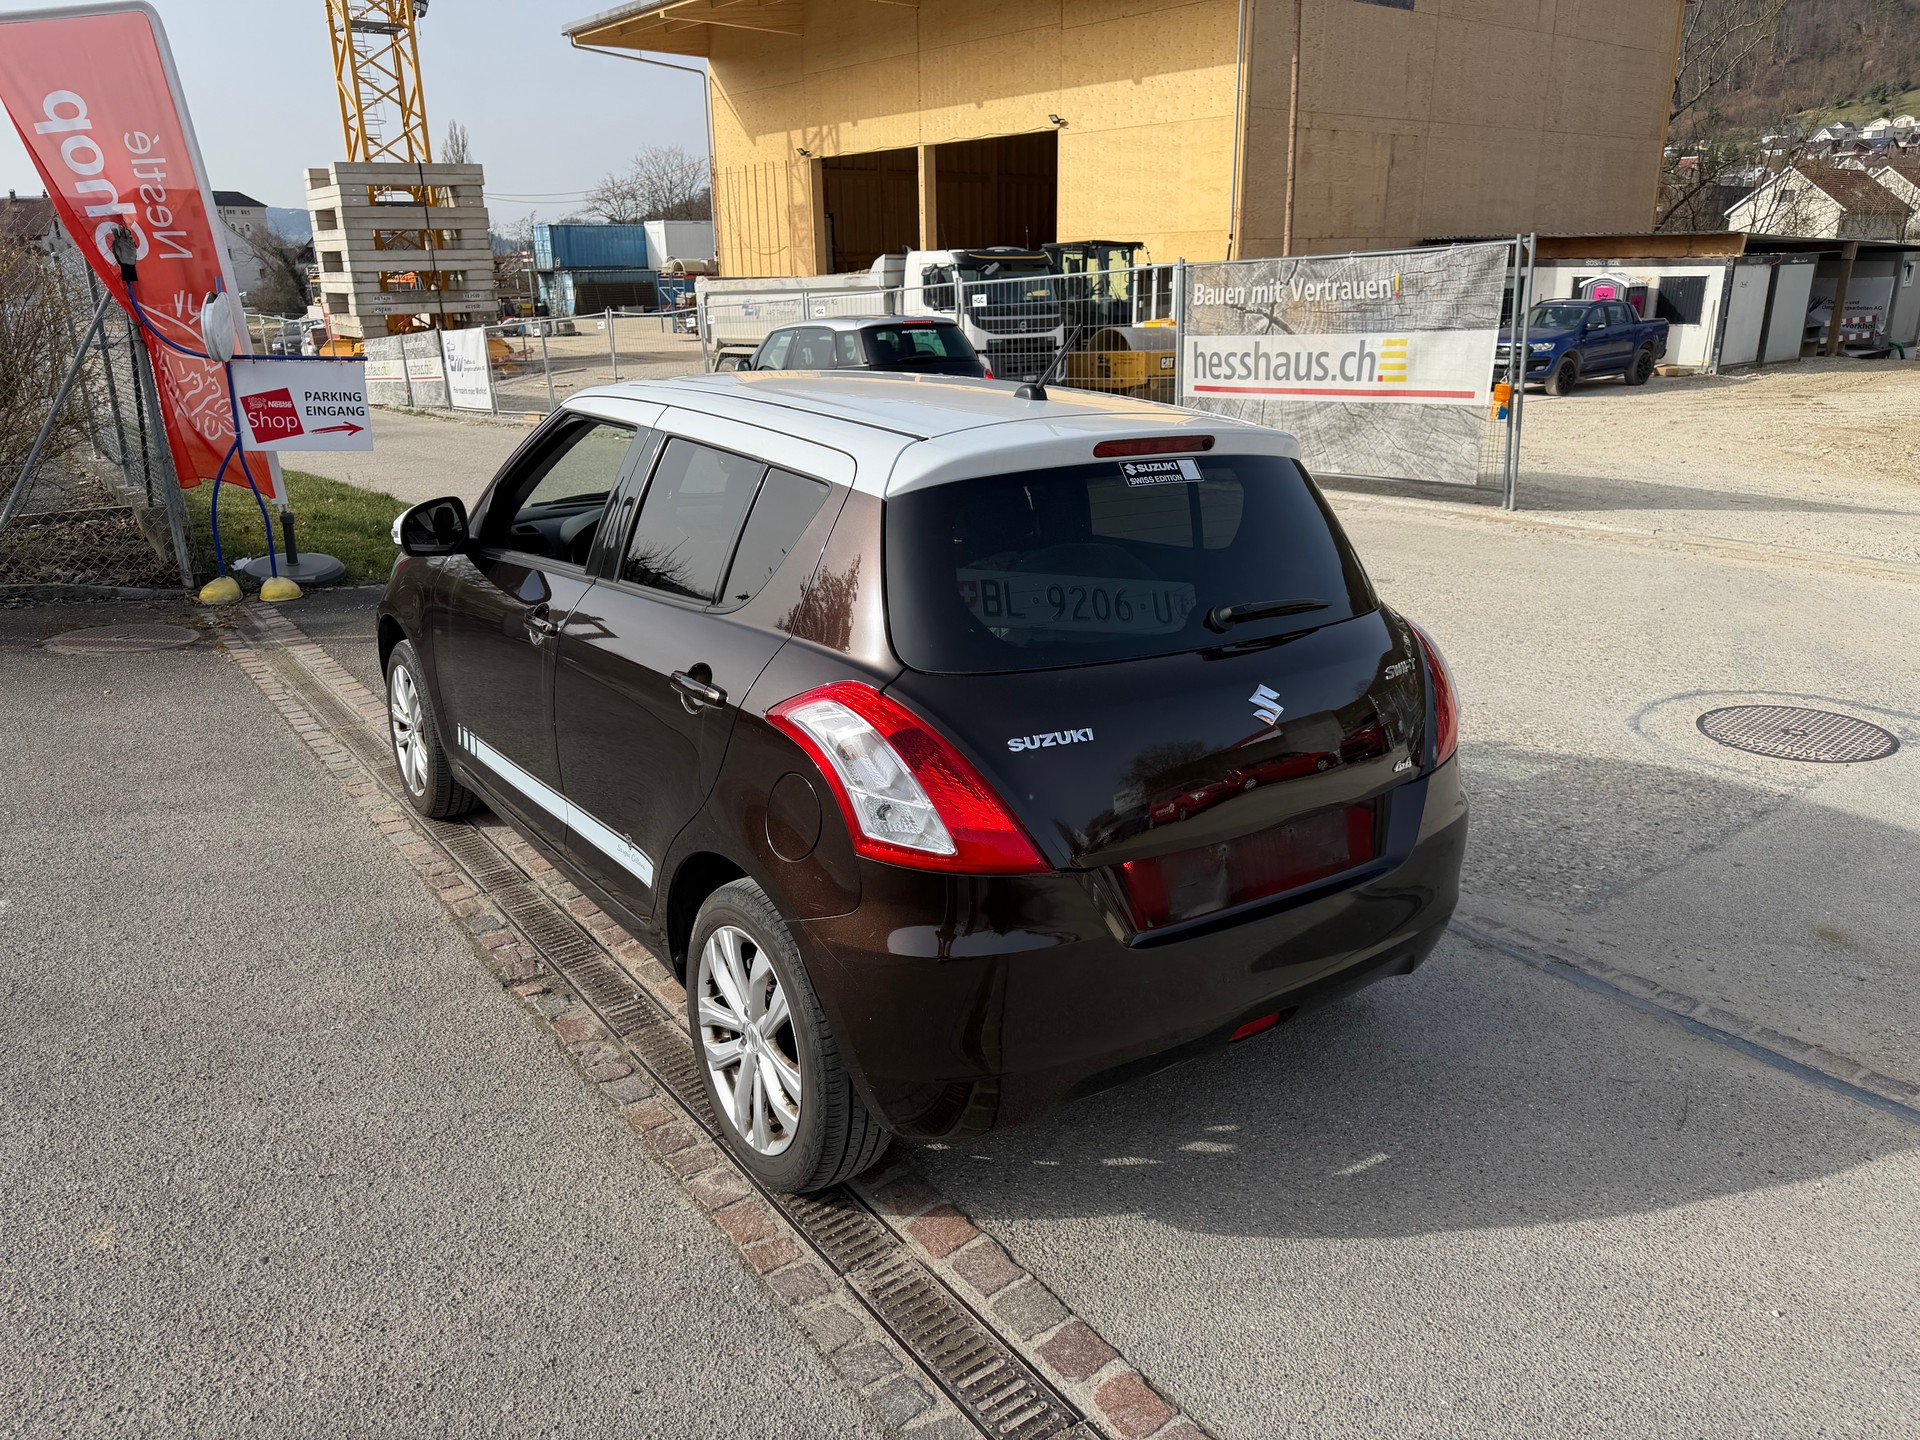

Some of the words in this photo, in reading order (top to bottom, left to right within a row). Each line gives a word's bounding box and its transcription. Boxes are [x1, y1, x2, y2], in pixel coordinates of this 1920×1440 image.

[1193, 282, 1245, 306] Bauen
[1251, 280, 1283, 303] mit
[1290, 271, 1400, 301] Vertrauen!
[1161, 357, 1174, 369] CAT
[1193, 339, 1377, 382] hesshaus.ch
[304, 391, 362, 402] PARKING
[306, 406, 365, 416] EINGANG
[248, 411, 298, 432] Shop
[1136, 462, 1178, 472] SUZUKI
[1129, 475, 1155, 485] SWISS
[1155, 474, 1183, 482] EDITION
[1045, 584, 1134, 622] 9206
[1007, 727, 1095, 752] SUZUKI
